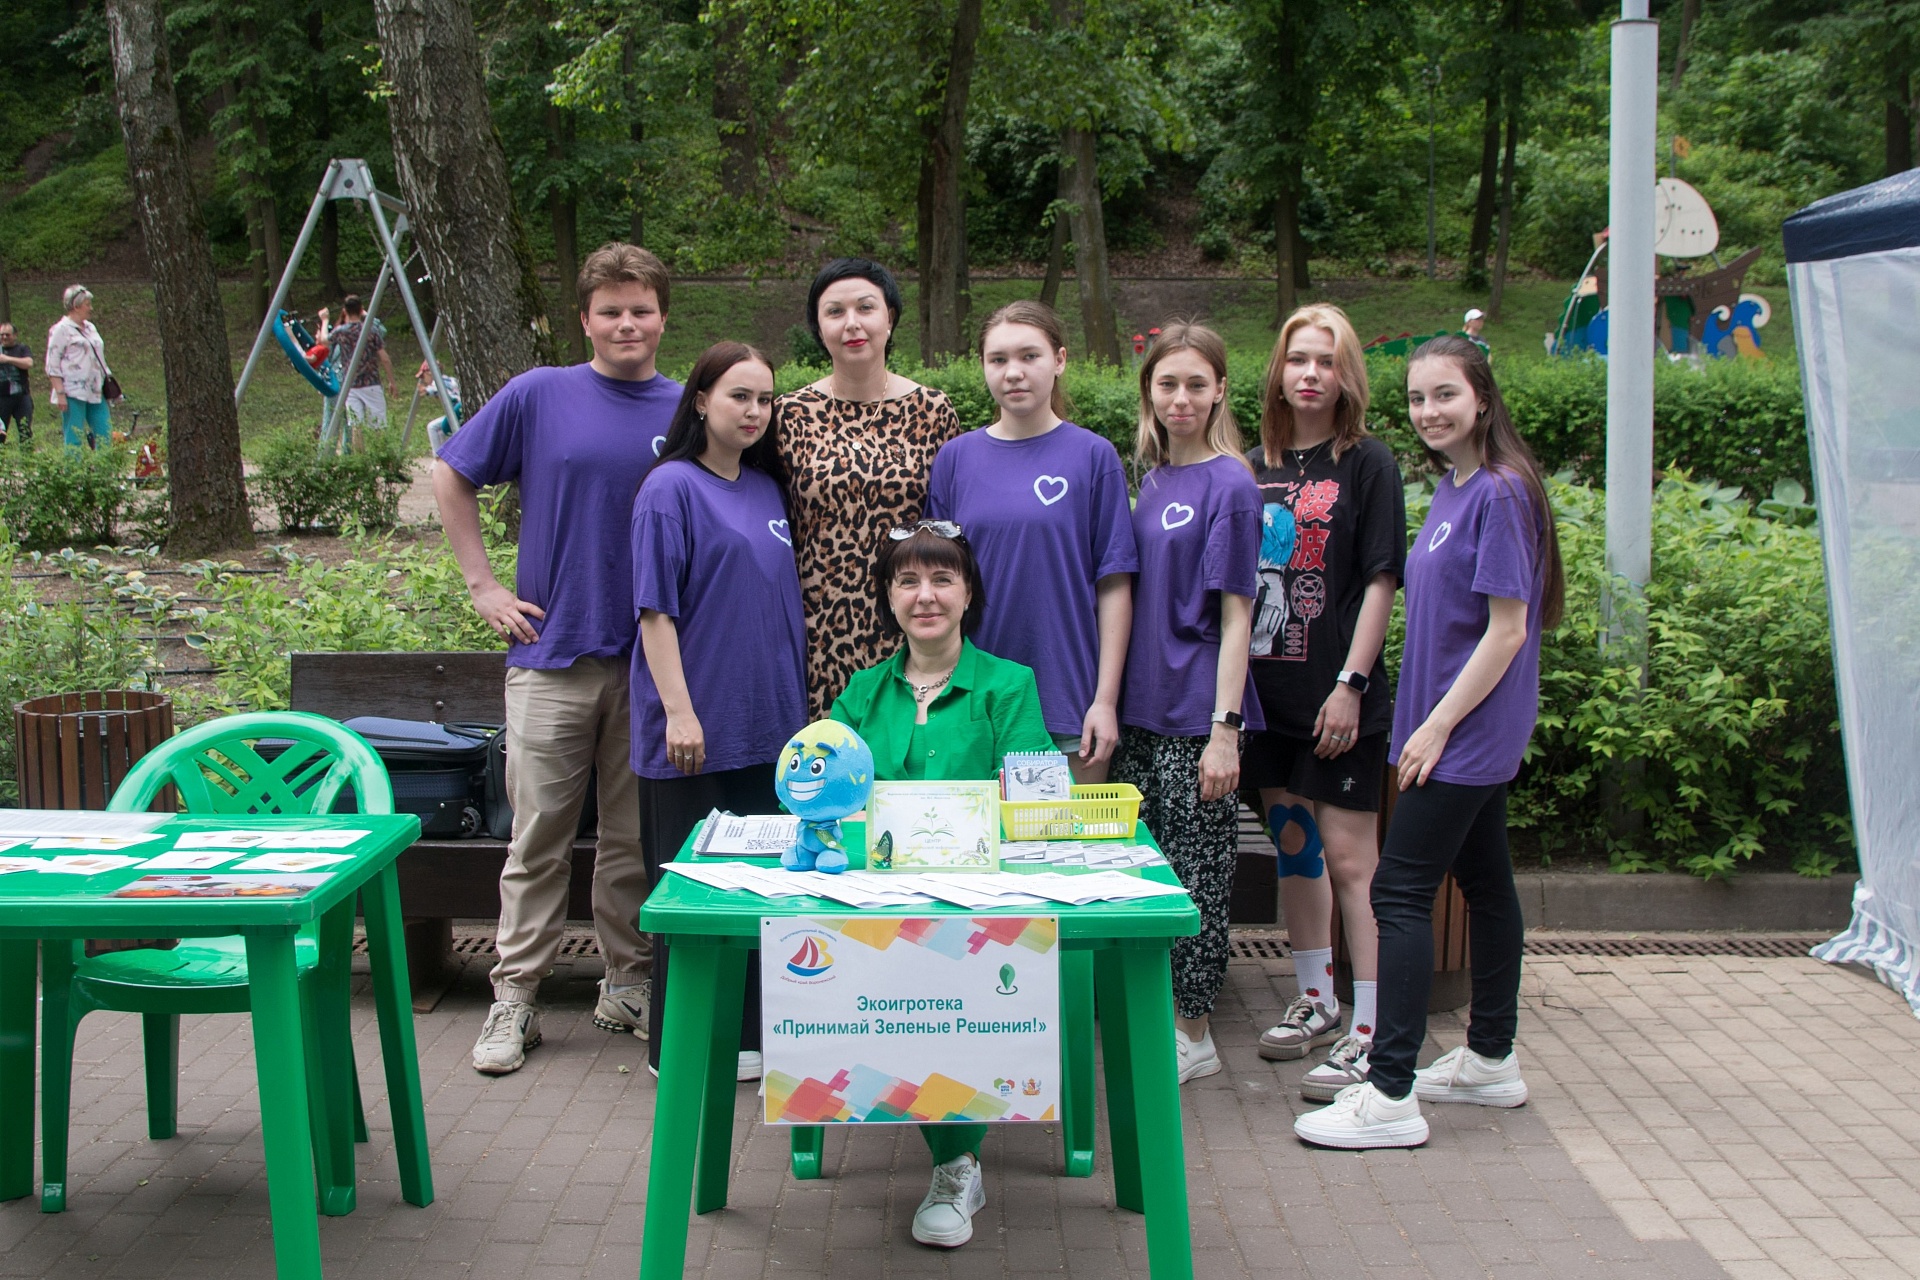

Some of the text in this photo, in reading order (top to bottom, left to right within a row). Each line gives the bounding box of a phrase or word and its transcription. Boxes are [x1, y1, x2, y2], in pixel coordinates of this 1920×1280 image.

[1289, 478, 1340, 572] 綾波
[1016, 759, 1059, 767] СОБИРАТОР
[856, 995, 963, 1014] Экоигротека
[773, 1017, 1047, 1038] «Принимай Зеленые Решения!»
